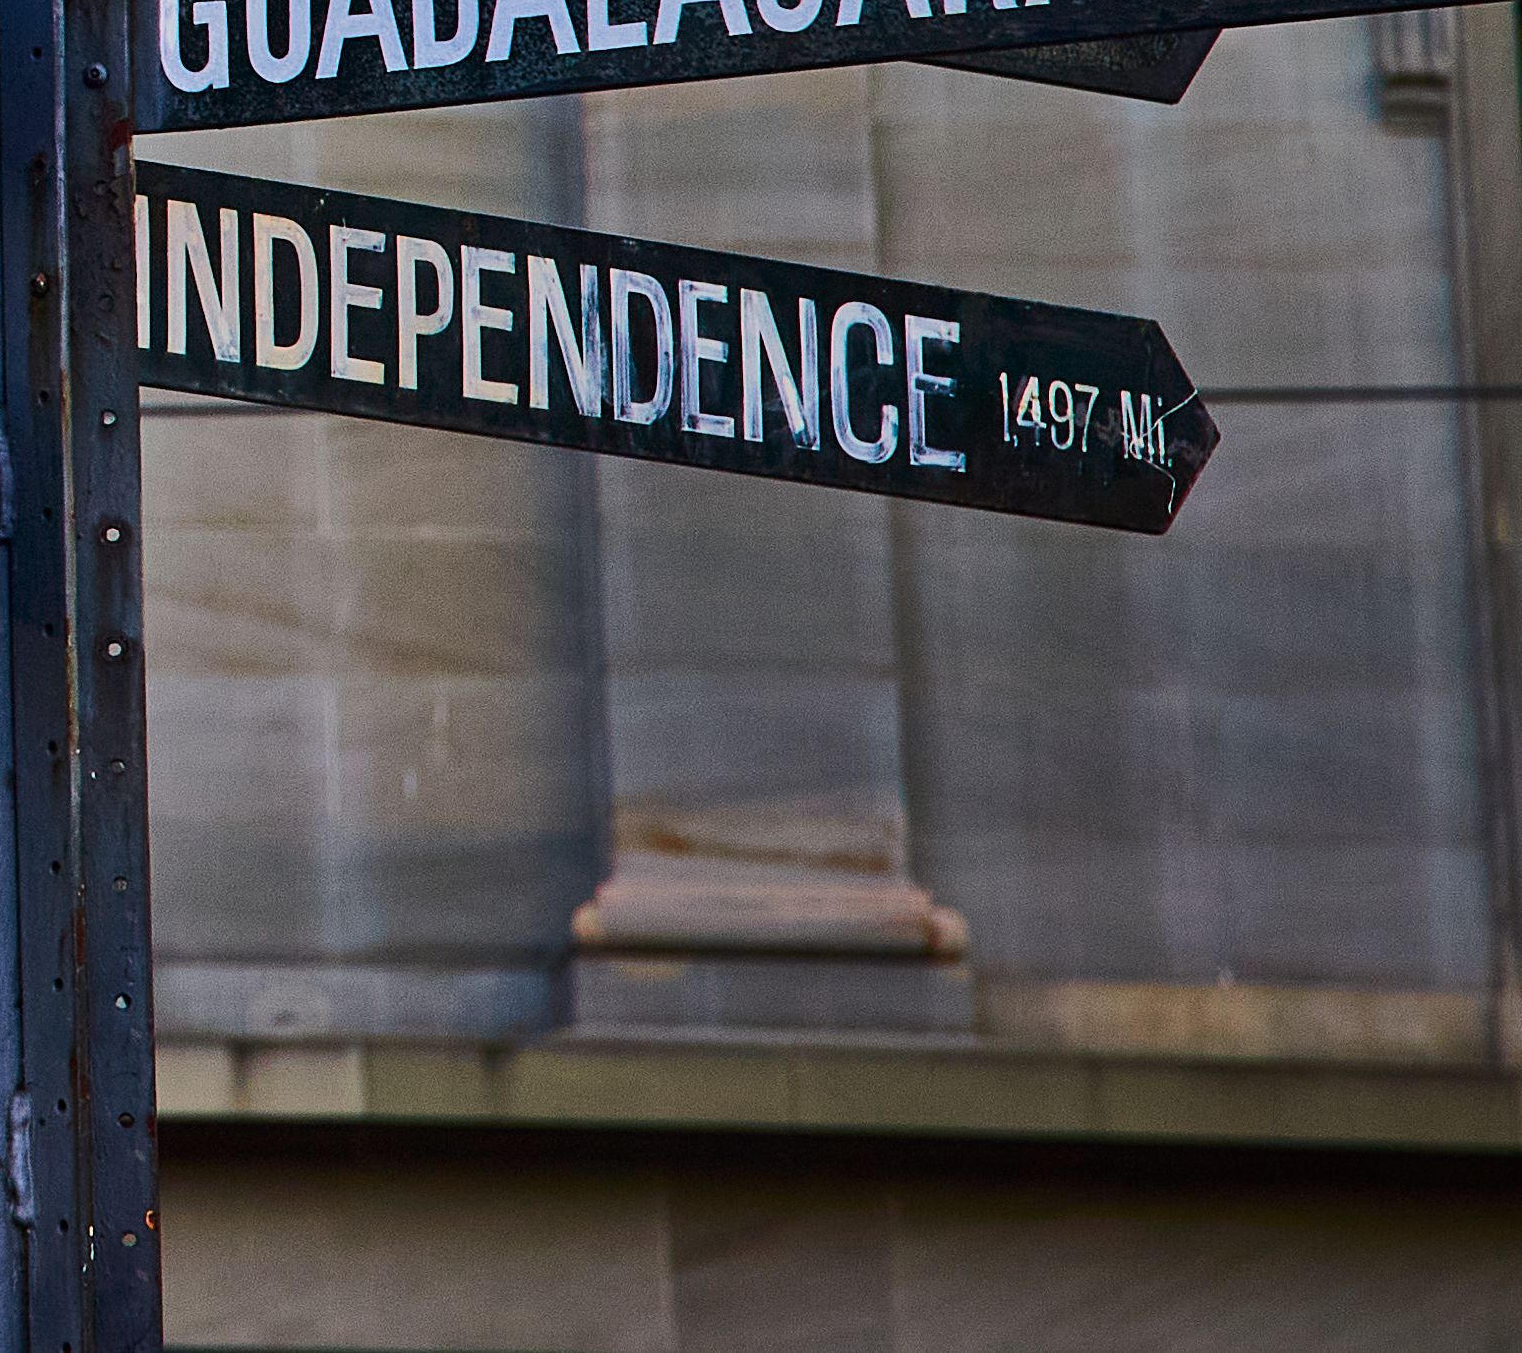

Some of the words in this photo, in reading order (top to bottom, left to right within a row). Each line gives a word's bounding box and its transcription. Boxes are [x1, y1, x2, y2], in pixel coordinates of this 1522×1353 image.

[134, 193, 966, 473] INDEPENDENCE
[999, 372, 1100, 453] 1,497
[1120, 389, 1173, 468] Mi.
